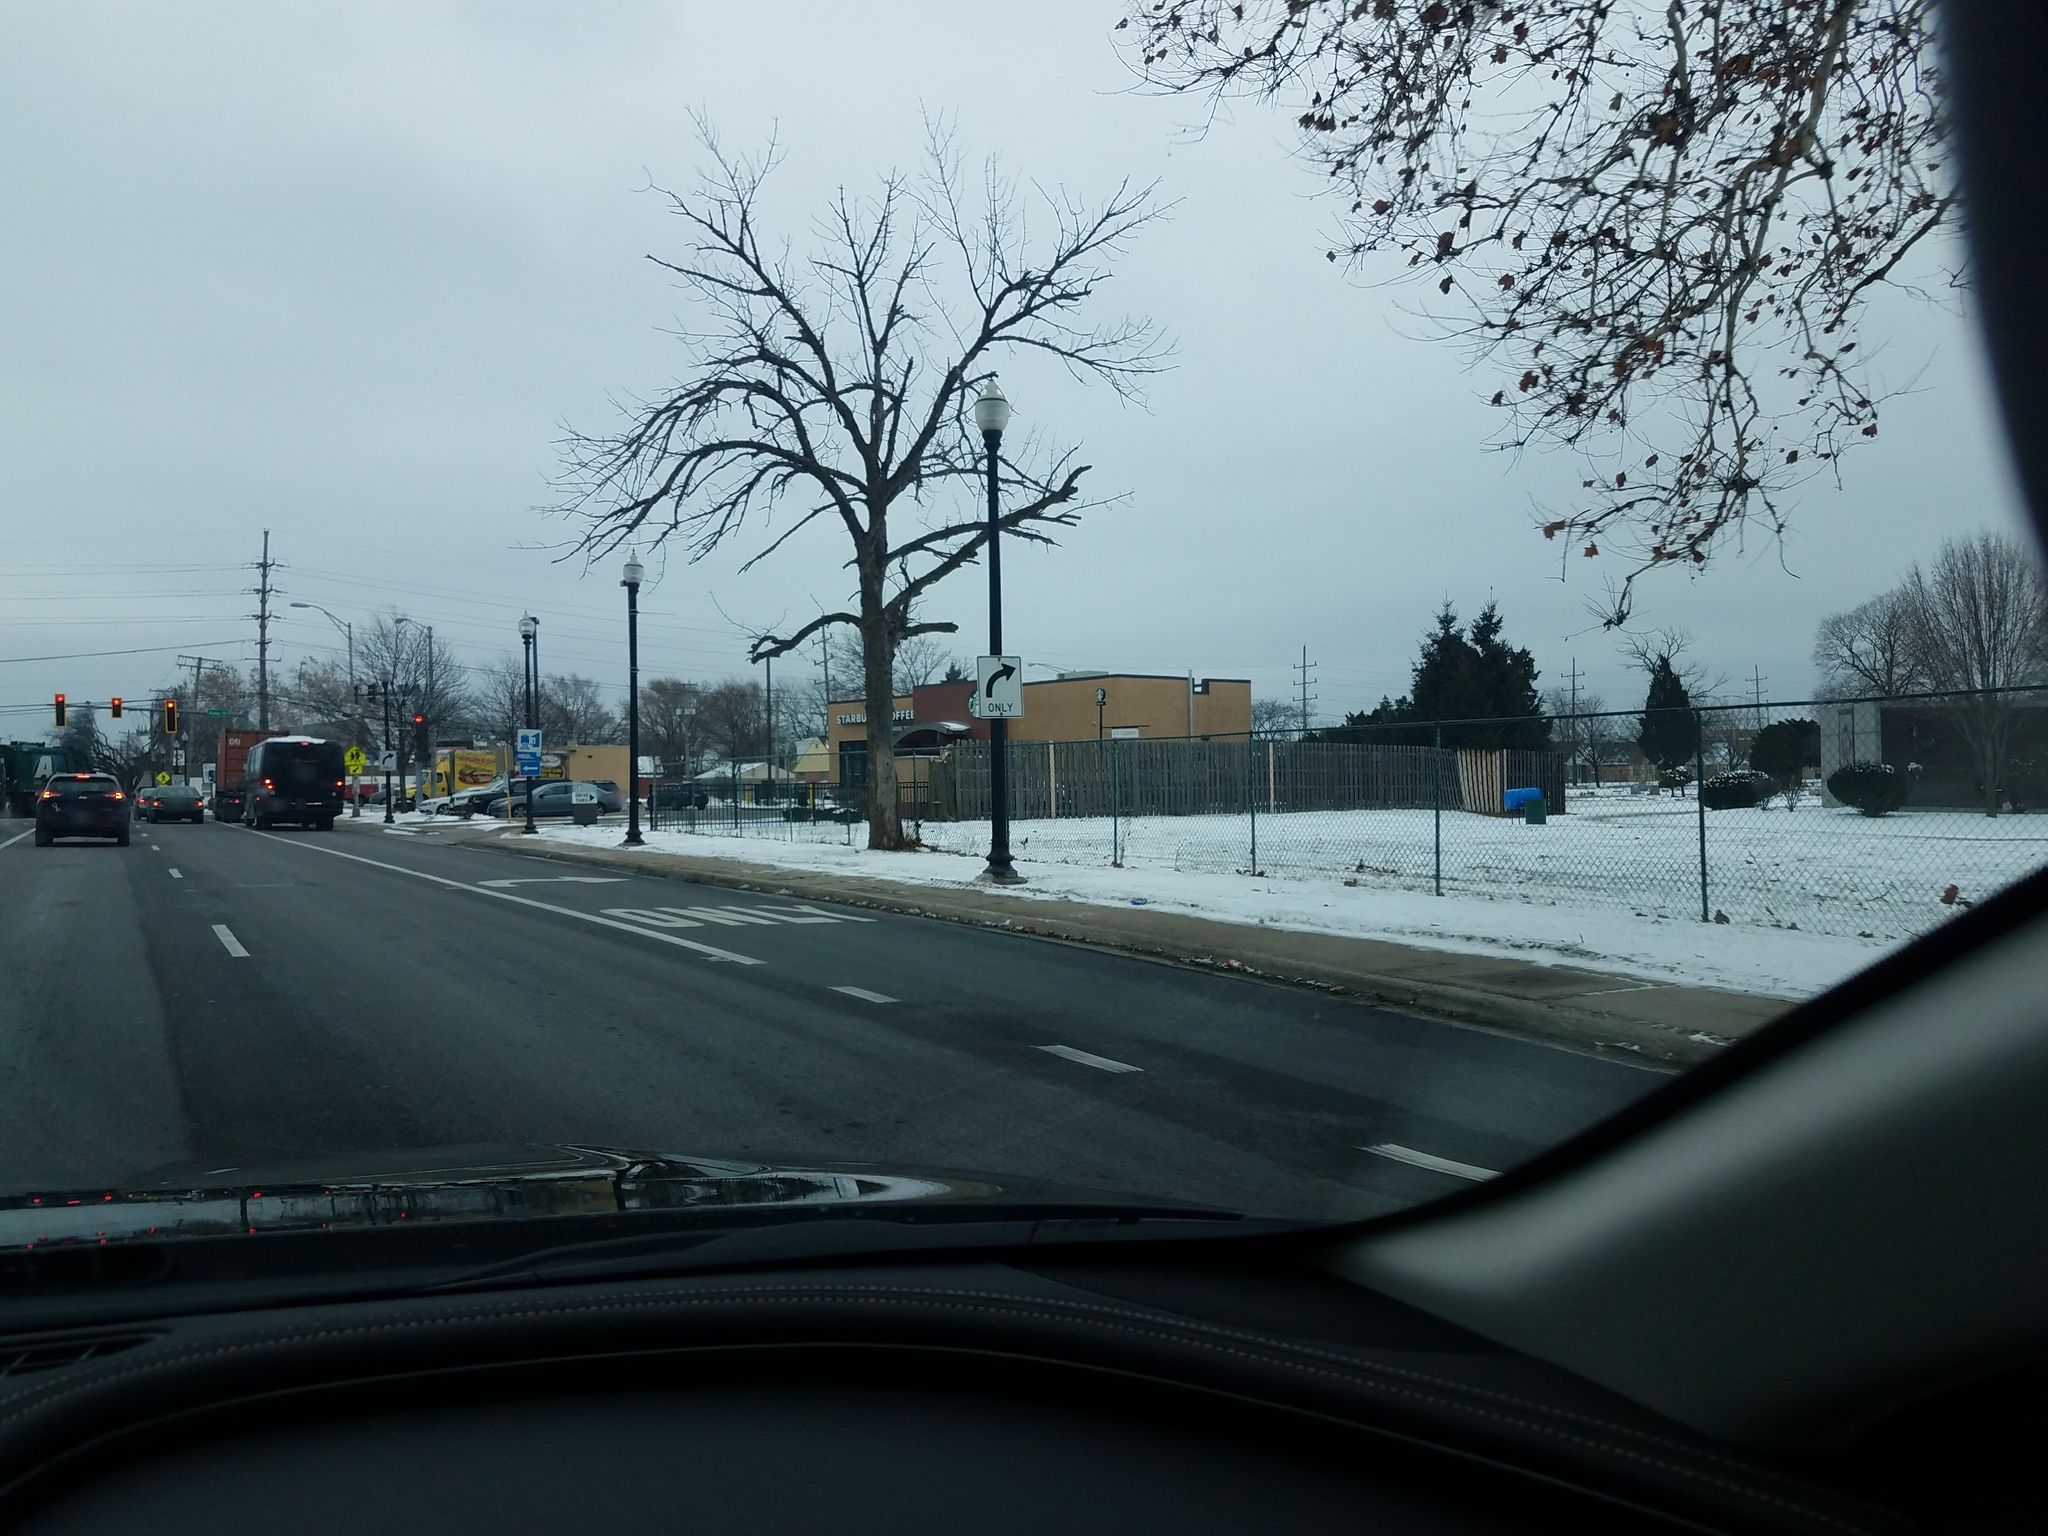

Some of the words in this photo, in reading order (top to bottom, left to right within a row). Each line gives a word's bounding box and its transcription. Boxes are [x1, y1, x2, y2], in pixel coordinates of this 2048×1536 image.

[988, 702, 1014, 713] ONLY
[836, 713, 867, 725] STARBU
[600, 905, 878, 928] ONLY
